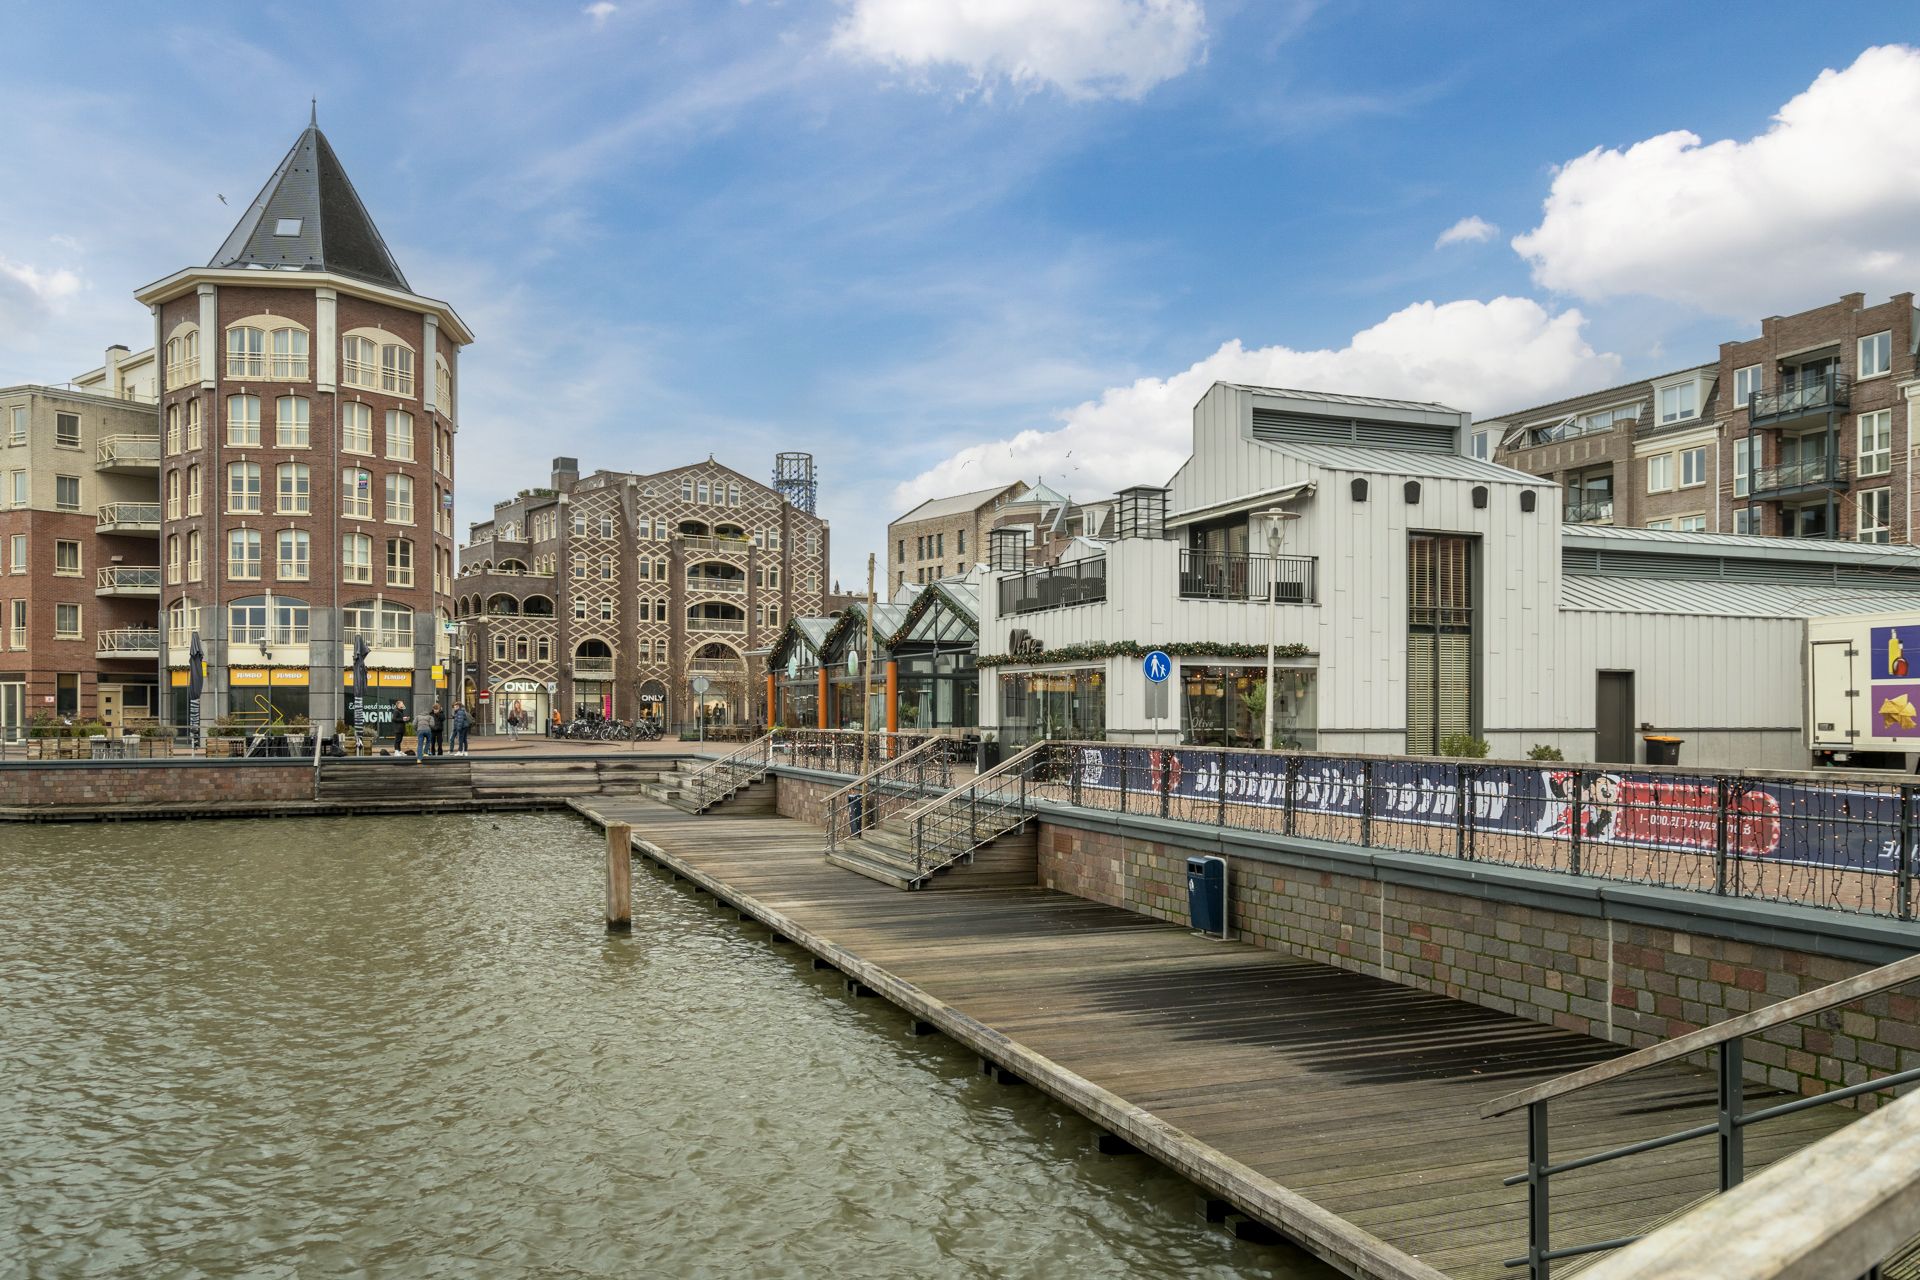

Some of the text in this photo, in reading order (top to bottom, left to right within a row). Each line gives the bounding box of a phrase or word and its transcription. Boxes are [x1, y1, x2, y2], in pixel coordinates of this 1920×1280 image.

[1009, 628, 1044, 655] Olive
[504, 682, 540, 692] ONLY
[641, 694, 664, 702] ONLY
[362, 711, 393, 723] NGAN
